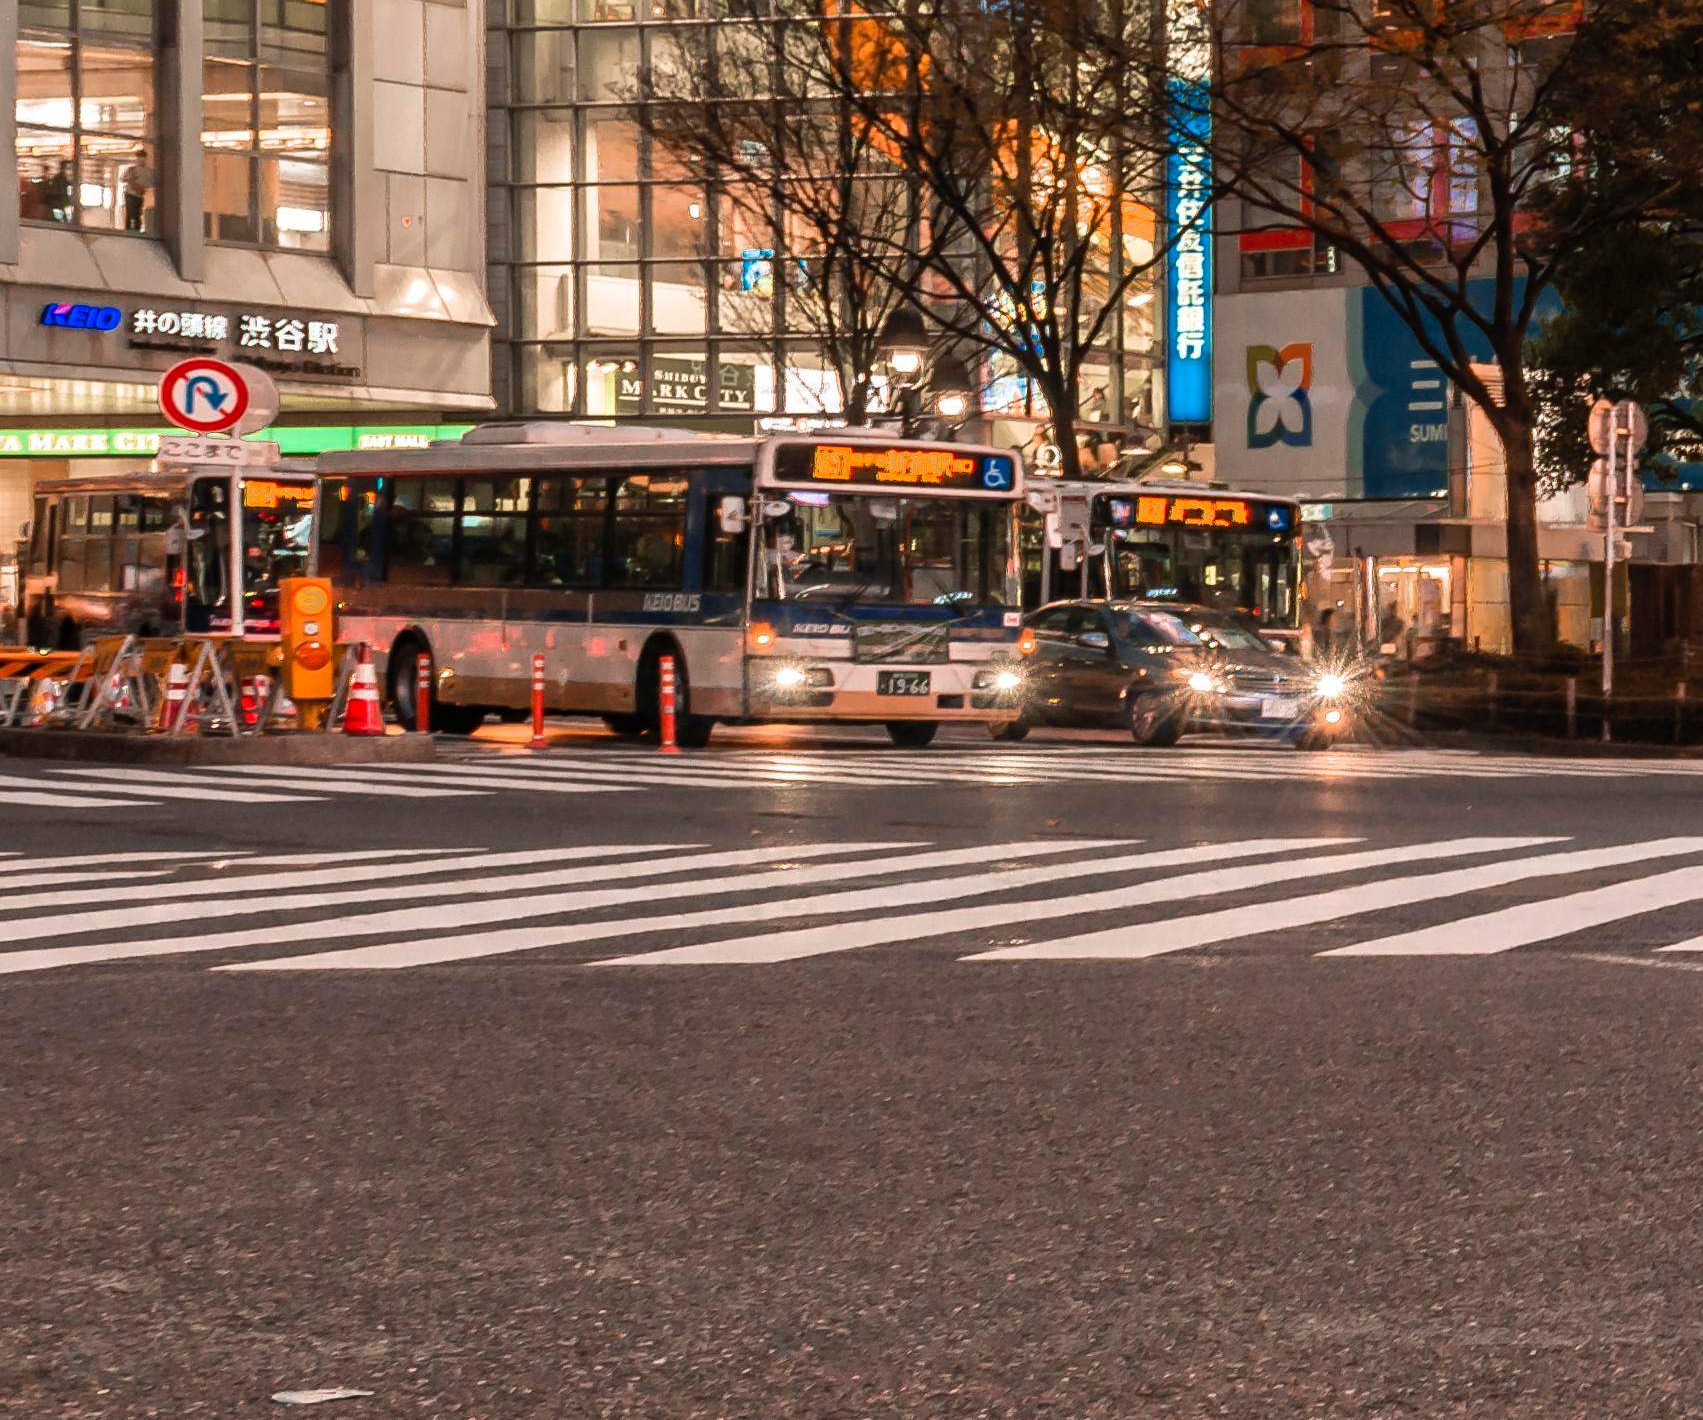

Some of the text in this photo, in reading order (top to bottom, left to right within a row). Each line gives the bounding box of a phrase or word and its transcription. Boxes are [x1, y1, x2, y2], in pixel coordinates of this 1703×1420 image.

[42, 302, 339, 355] KEIO 井の頭線 渋谷駅
